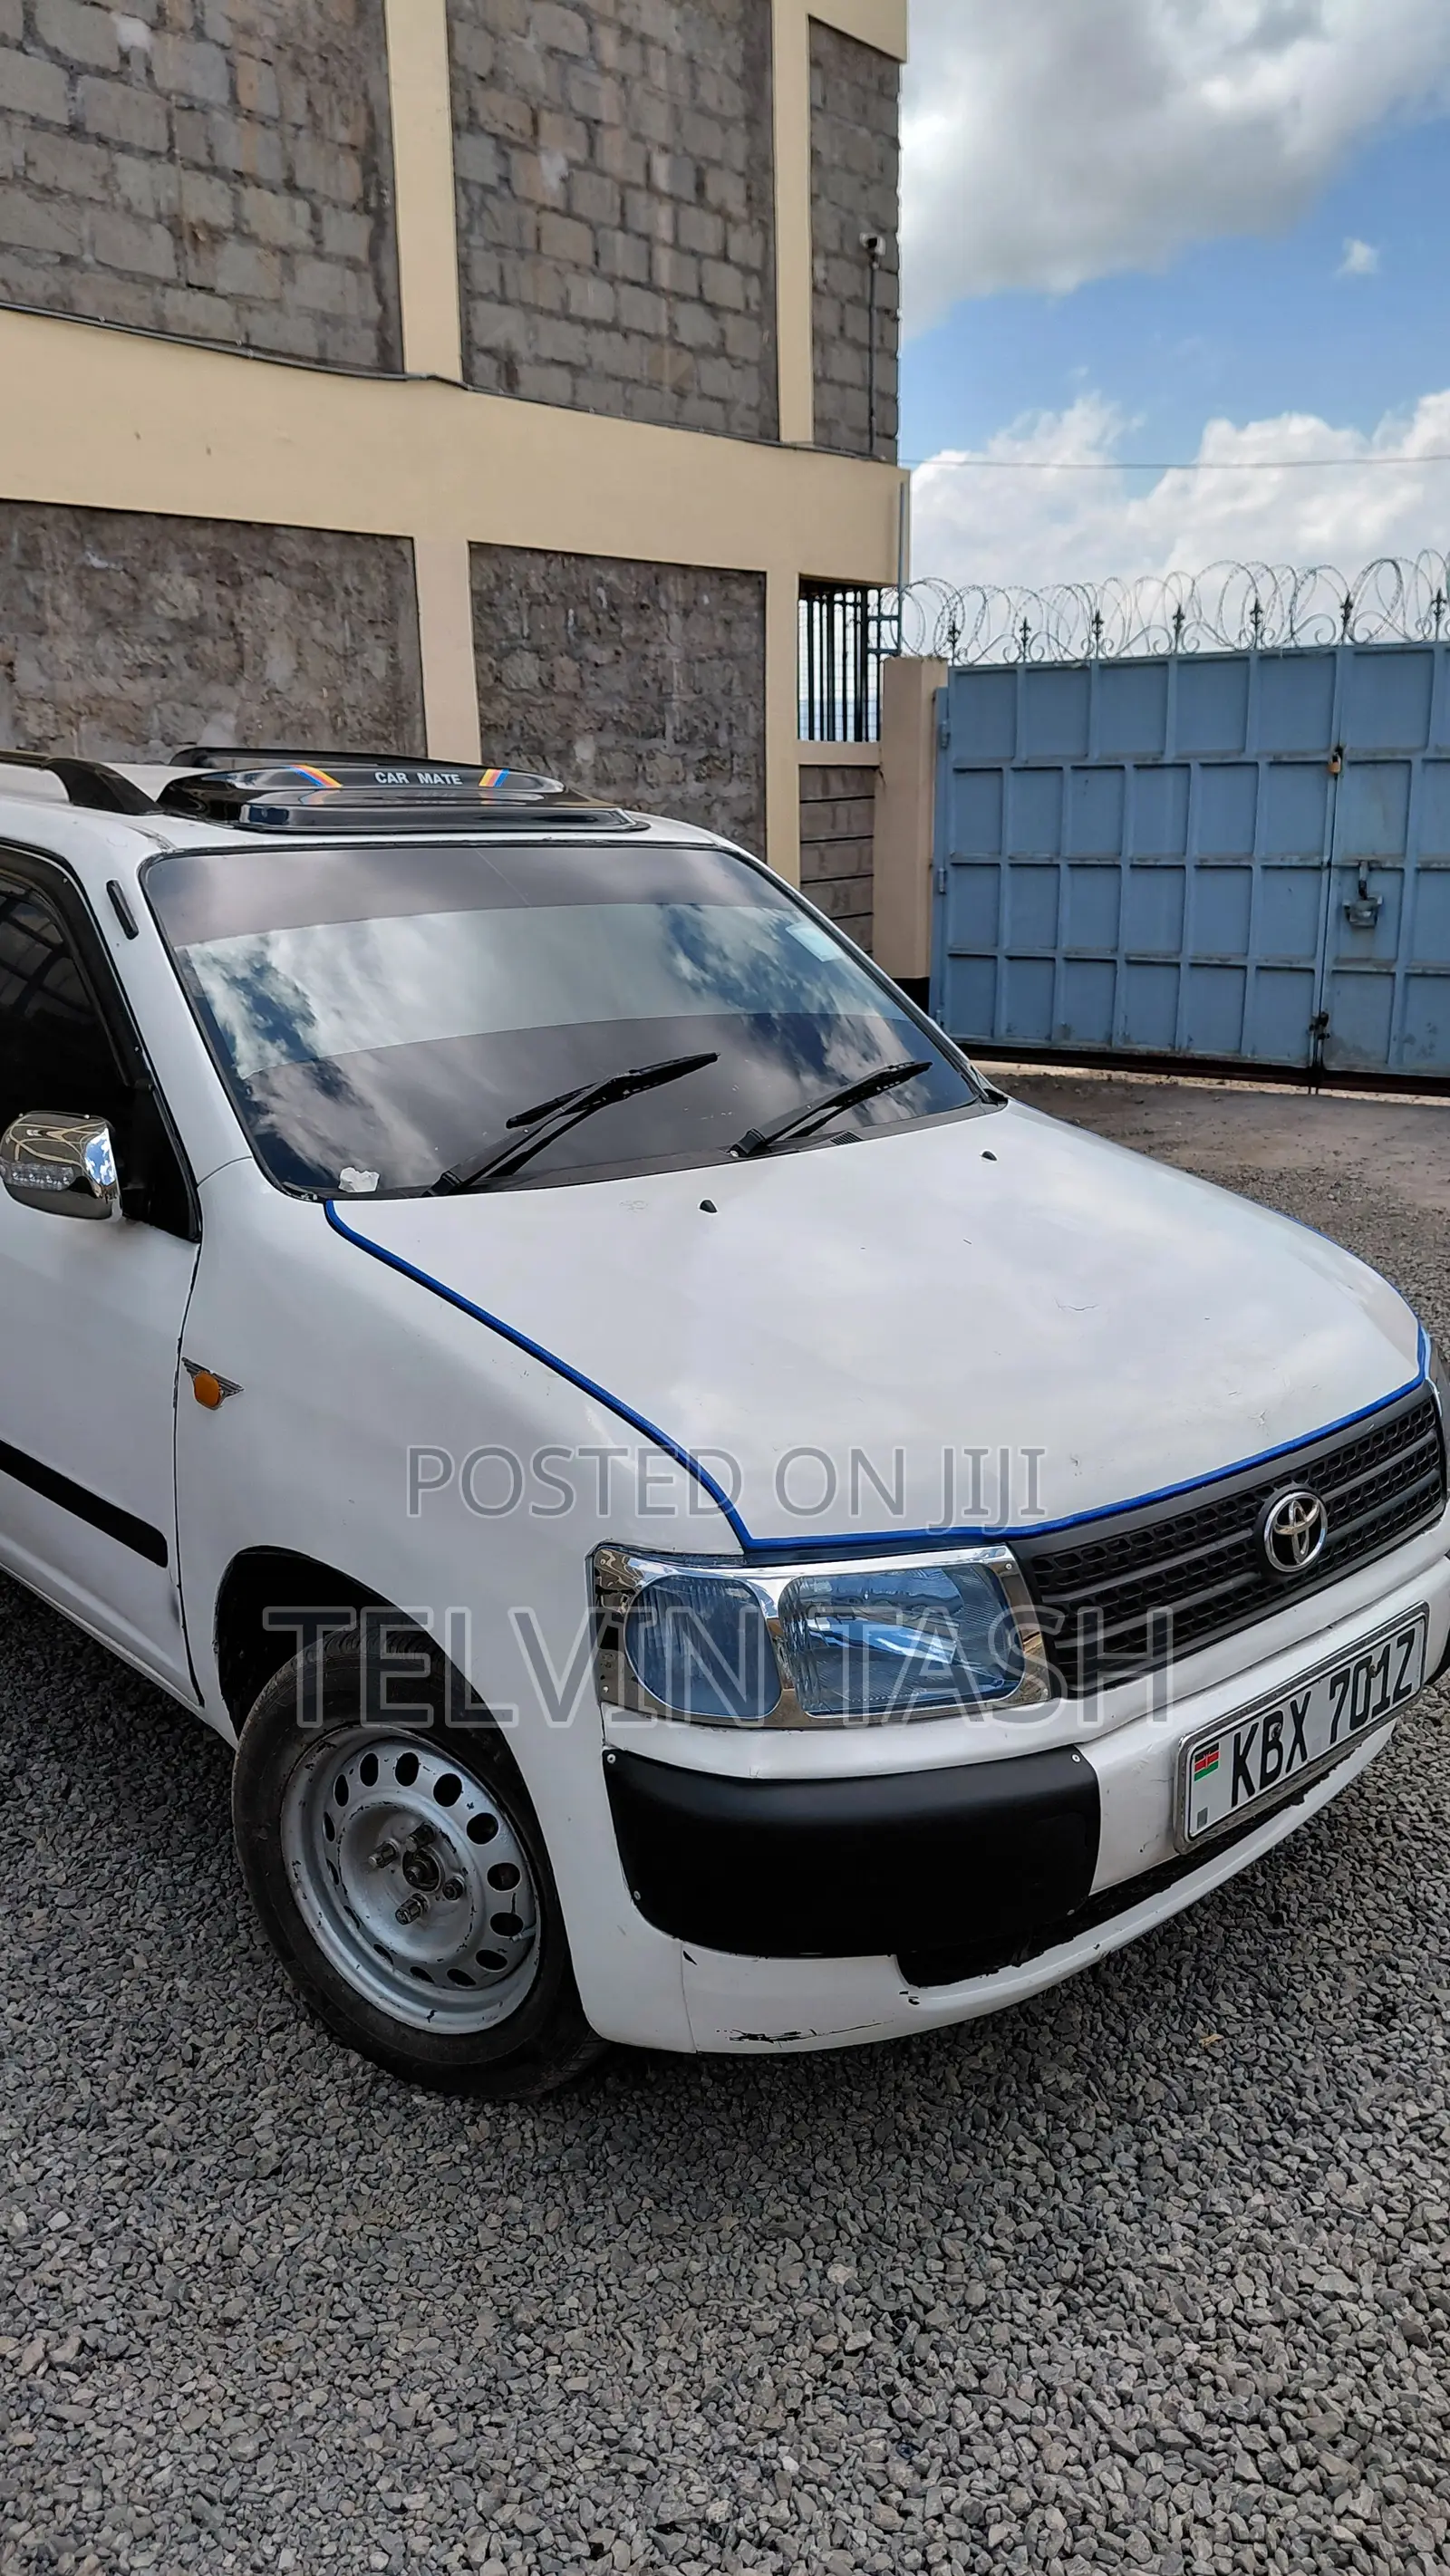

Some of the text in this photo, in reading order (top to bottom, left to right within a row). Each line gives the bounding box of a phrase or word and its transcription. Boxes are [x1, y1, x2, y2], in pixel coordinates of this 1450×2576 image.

[374, 771, 463, 786] CAR MATE
[1231, 1627, 1416, 1809] KBX 701Z
